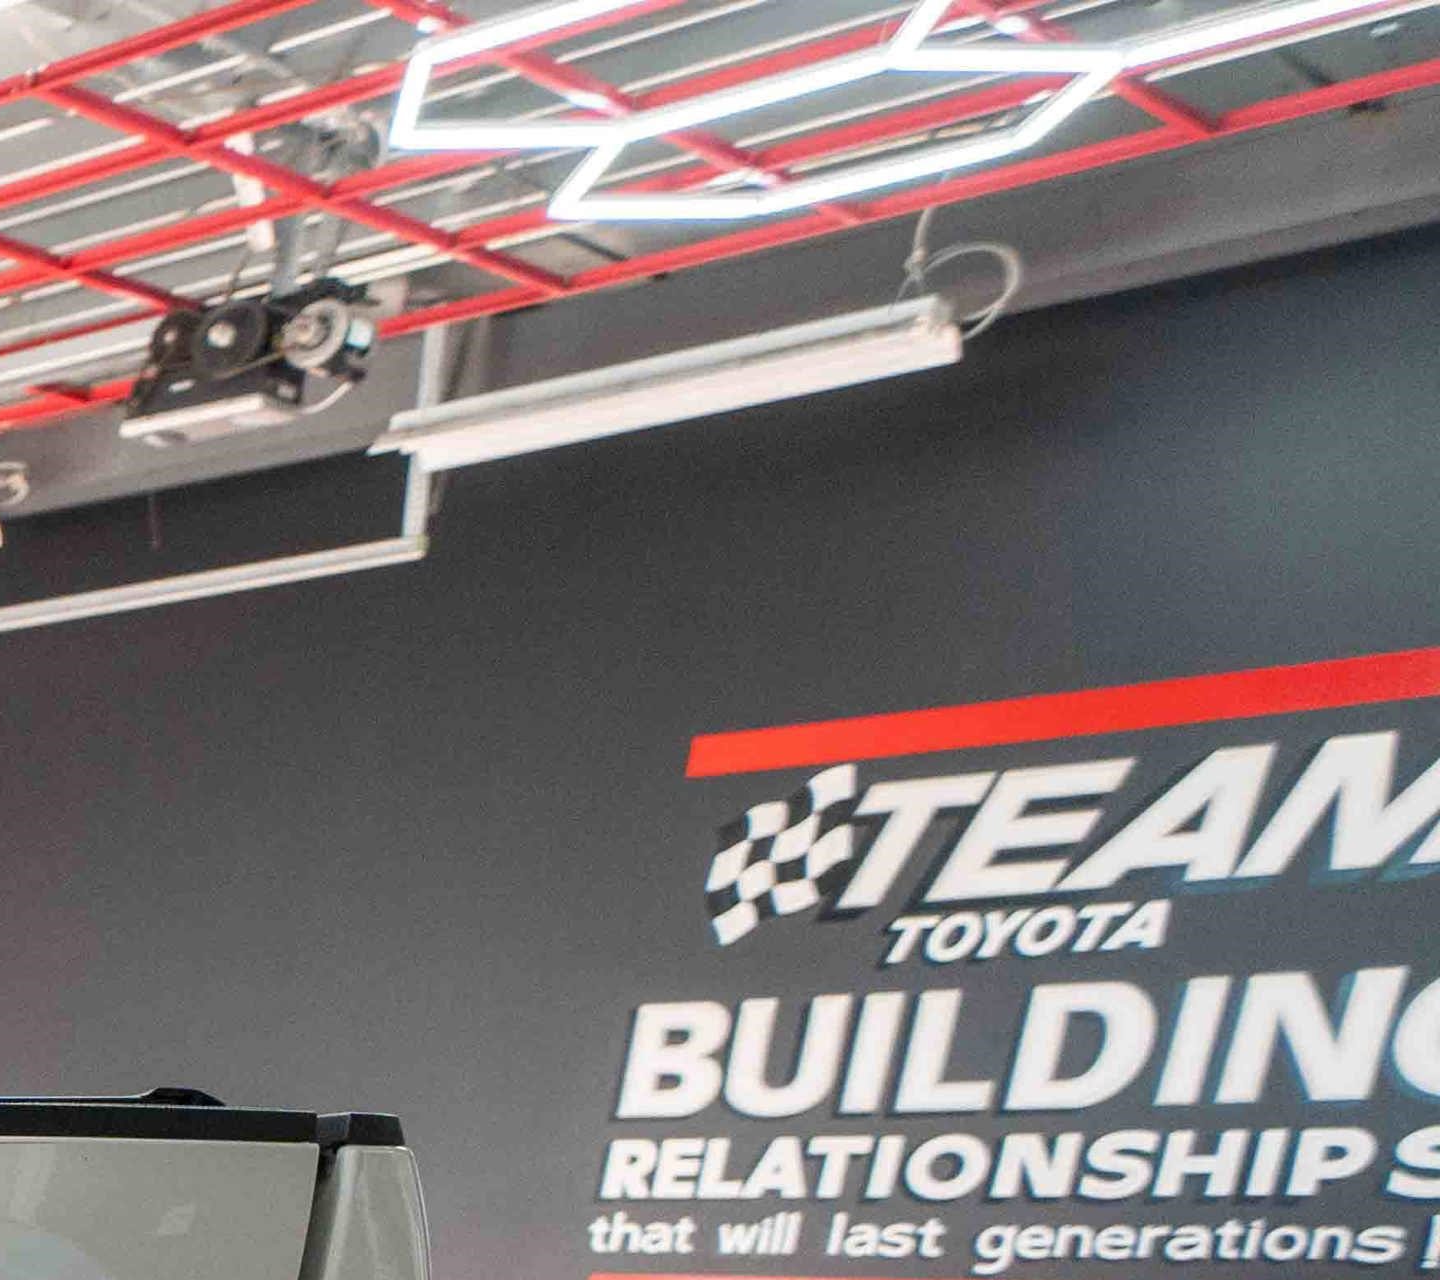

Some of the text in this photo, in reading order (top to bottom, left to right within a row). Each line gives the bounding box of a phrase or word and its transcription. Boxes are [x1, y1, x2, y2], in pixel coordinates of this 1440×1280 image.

[885, 899, 1170, 965] TOYOTA
[588, 1211, 695, 1253] that
[718, 1212, 801, 1254] will
[826, 1212, 947, 1257] last
[973, 1219, 1406, 1275] generations
